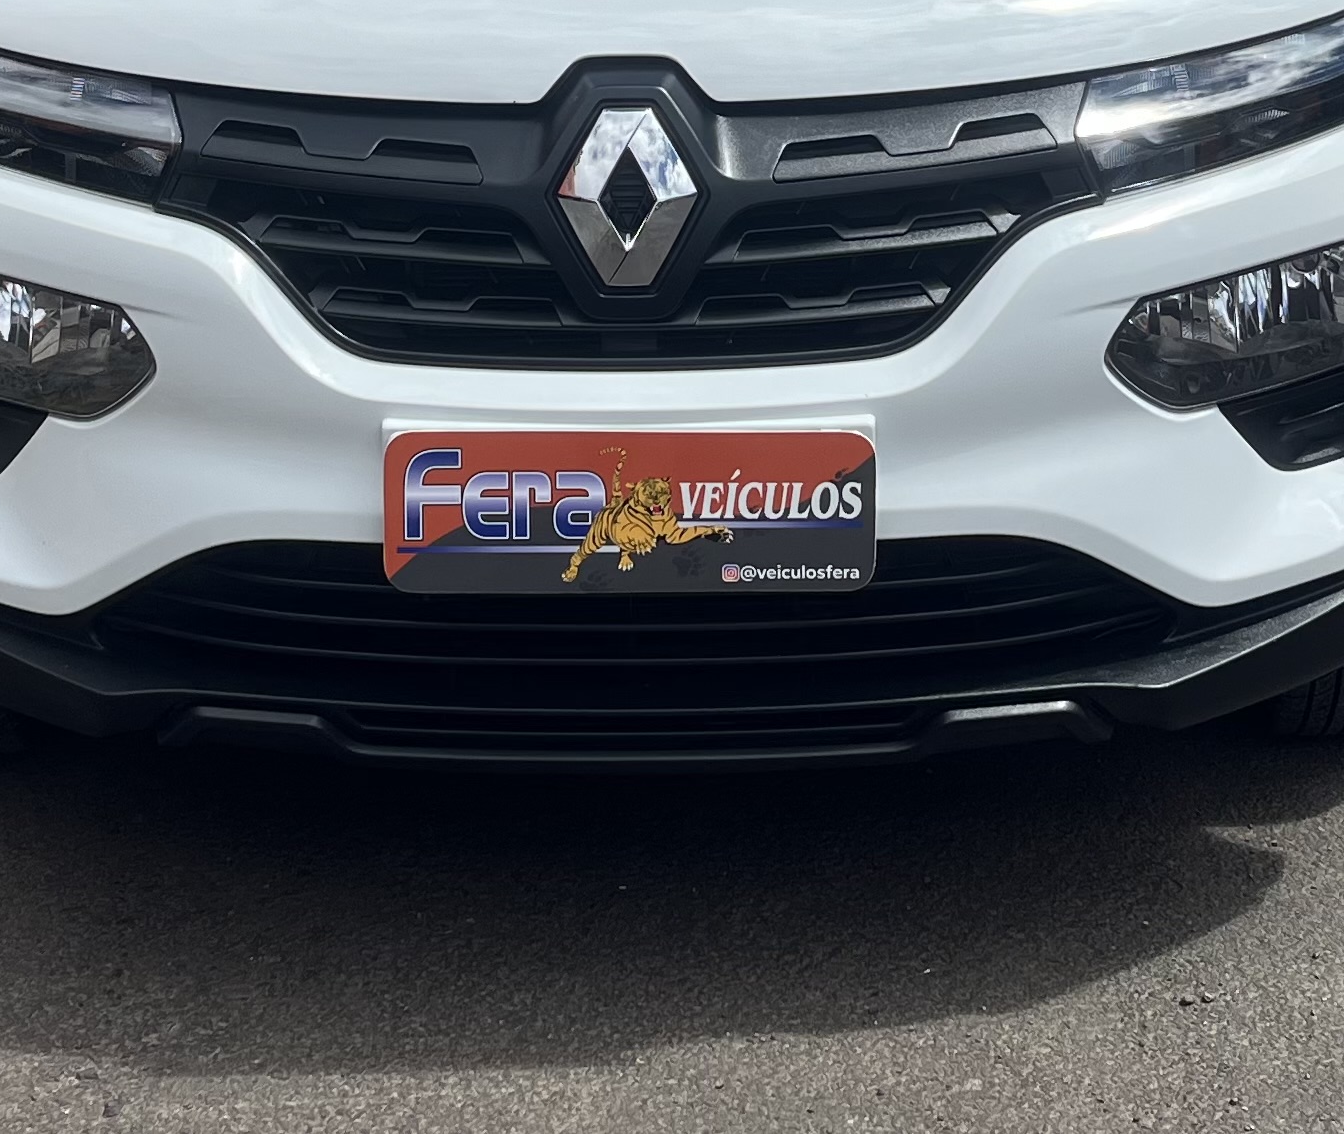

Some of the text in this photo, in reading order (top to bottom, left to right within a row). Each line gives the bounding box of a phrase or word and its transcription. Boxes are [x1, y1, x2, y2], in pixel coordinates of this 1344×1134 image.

[404, 448, 863, 541] Fera VEÍCULOS
[740, 564, 860, 581] @veiculosfera
